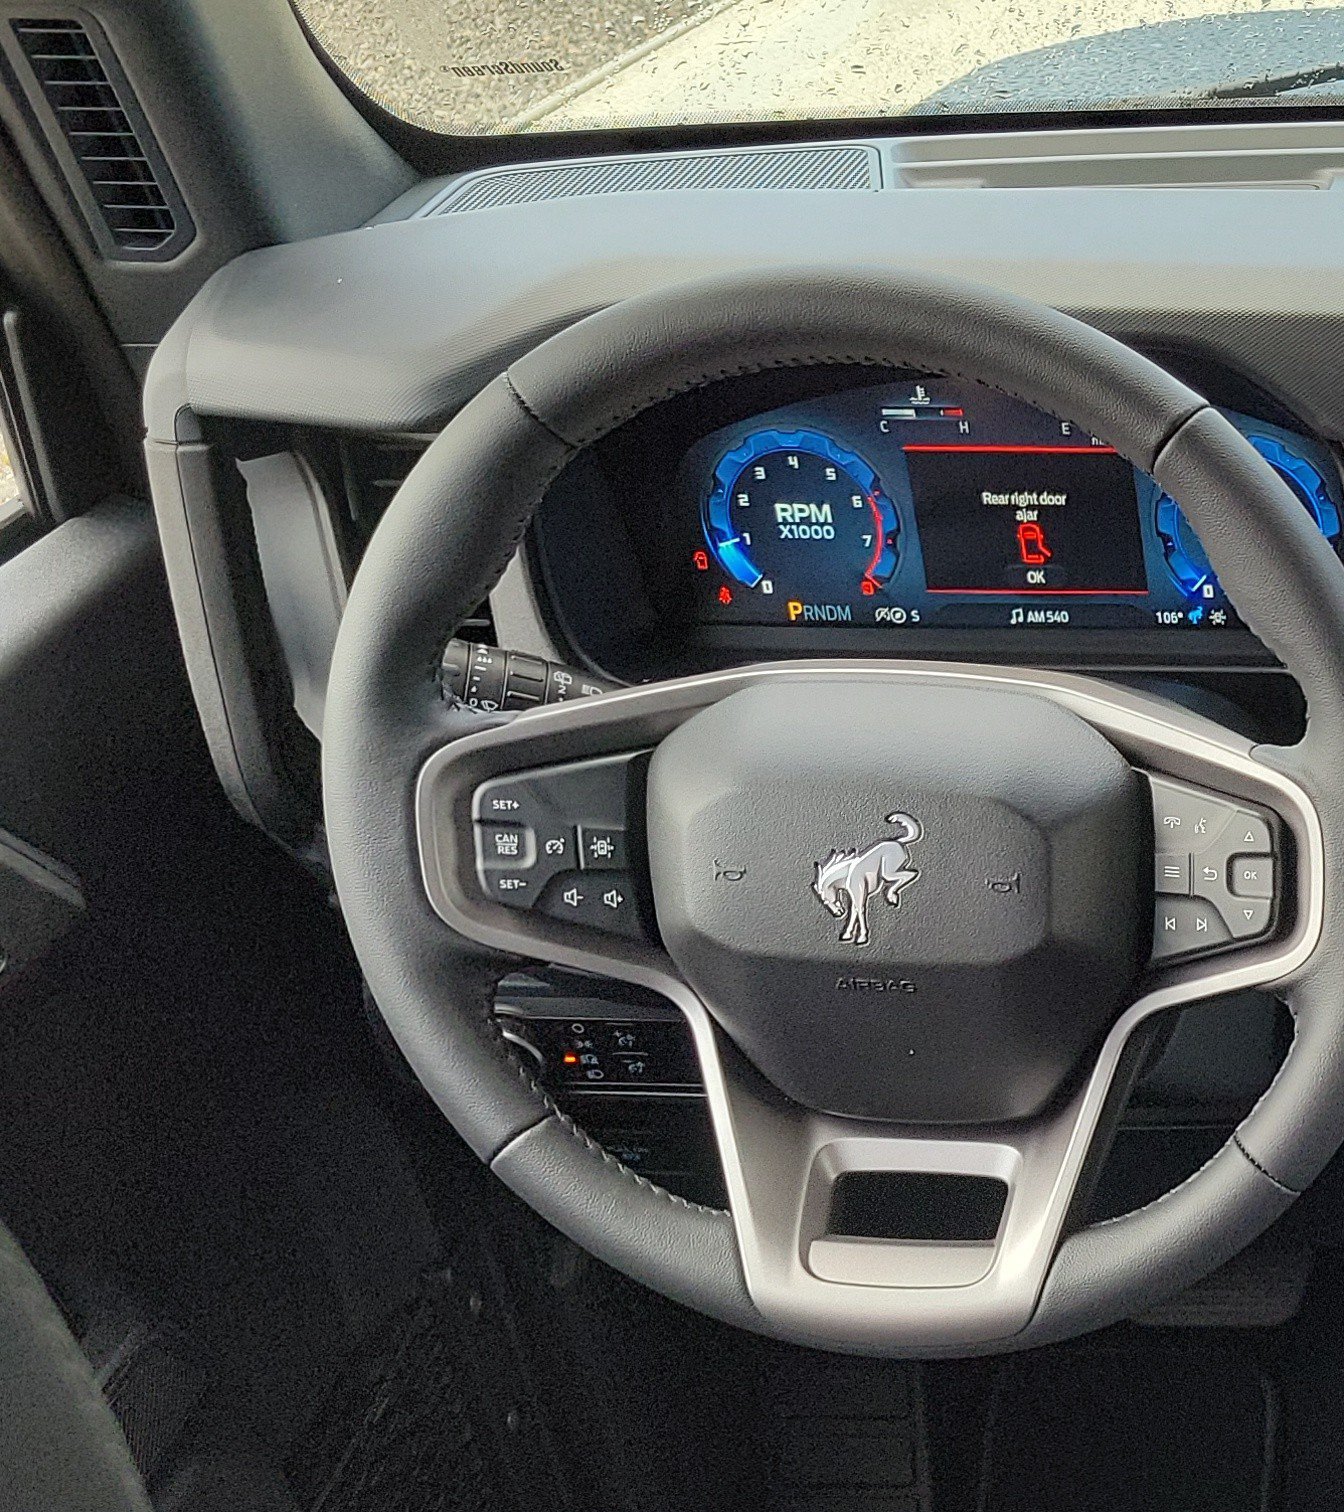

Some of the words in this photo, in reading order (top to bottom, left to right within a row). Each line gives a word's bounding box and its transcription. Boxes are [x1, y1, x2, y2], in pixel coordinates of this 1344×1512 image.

[880, 420, 889, 432] C
[959, 421, 969, 434] H
[1061, 422, 1070, 435] E
[787, 456, 799, 469] 4
[754, 467, 766, 480] 3
[825, 468, 836, 481] 5
[738, 494, 750, 507] 2
[852, 495, 863, 508] 6
[982, 492, 1009, 505] Rear
[1010, 491, 1039, 507] right
[1040, 491, 1067, 505] door
[774, 503, 833, 523] RPM
[1015, 508, 1038, 523] ajar
[779, 525, 835, 539] X1000
[742, 533, 751, 545] 1
[862, 535, 872, 547] 7
[1027, 570, 1045, 584] OK
[761, 580, 773, 594] 0
[1203, 584, 1214, 598] 0
[1027, 610, 1045, 623] AM
[1046, 610, 1069, 623] 540
[492, 800, 520, 810] SET+
[495, 834, 518, 843] CAN
[497, 846, 518, 855] RES
[1243, 870, 1258, 880] OK
